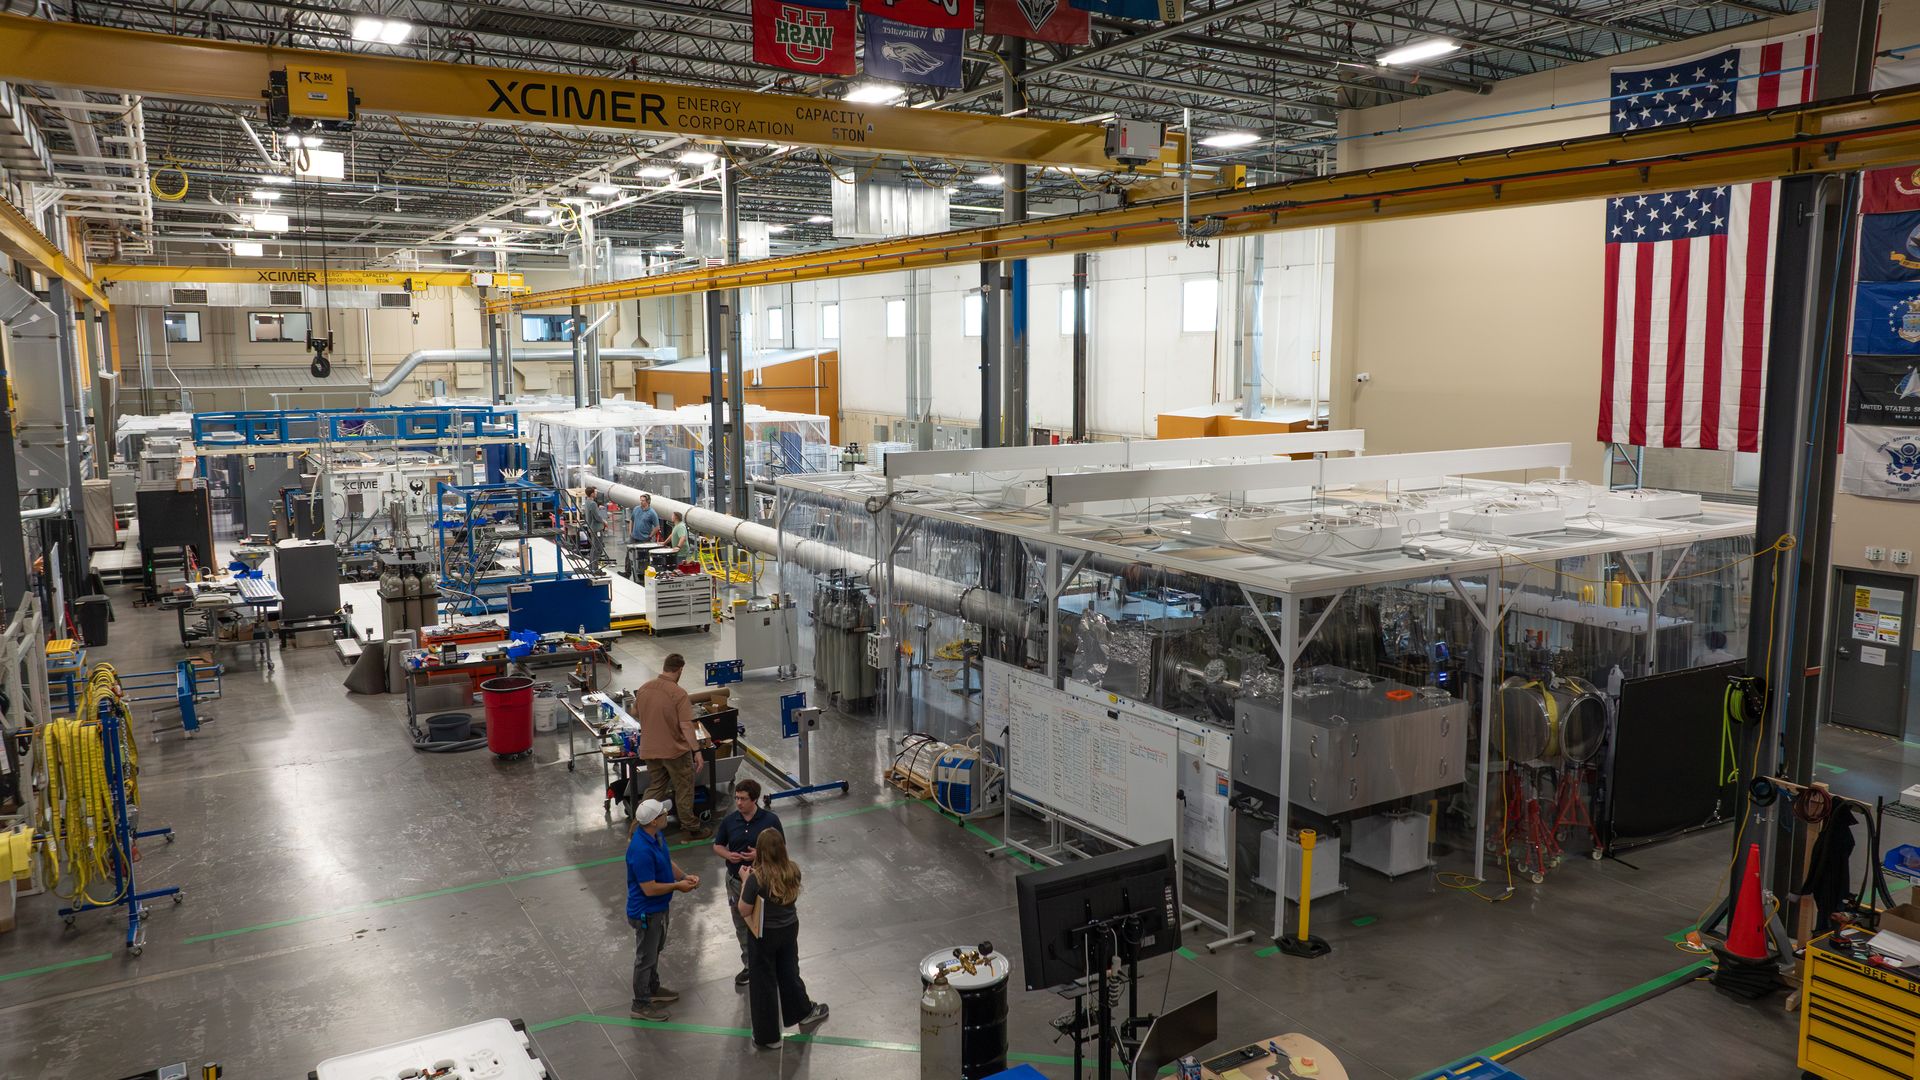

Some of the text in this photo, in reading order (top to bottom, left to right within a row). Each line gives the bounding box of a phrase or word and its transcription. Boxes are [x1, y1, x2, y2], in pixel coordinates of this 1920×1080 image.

[486, 79, 669, 126] XCIMER
[677, 96, 741, 114] ENERGY
[796, 107, 865, 125] CAPACITY
[678, 114, 794, 136] CORPORATION
[832, 128, 865, 142] 5TON
[257, 271, 318, 283] XCIMER
[342, 481, 378, 490] XCIME
[1863, 966, 1888, 982] BEE
